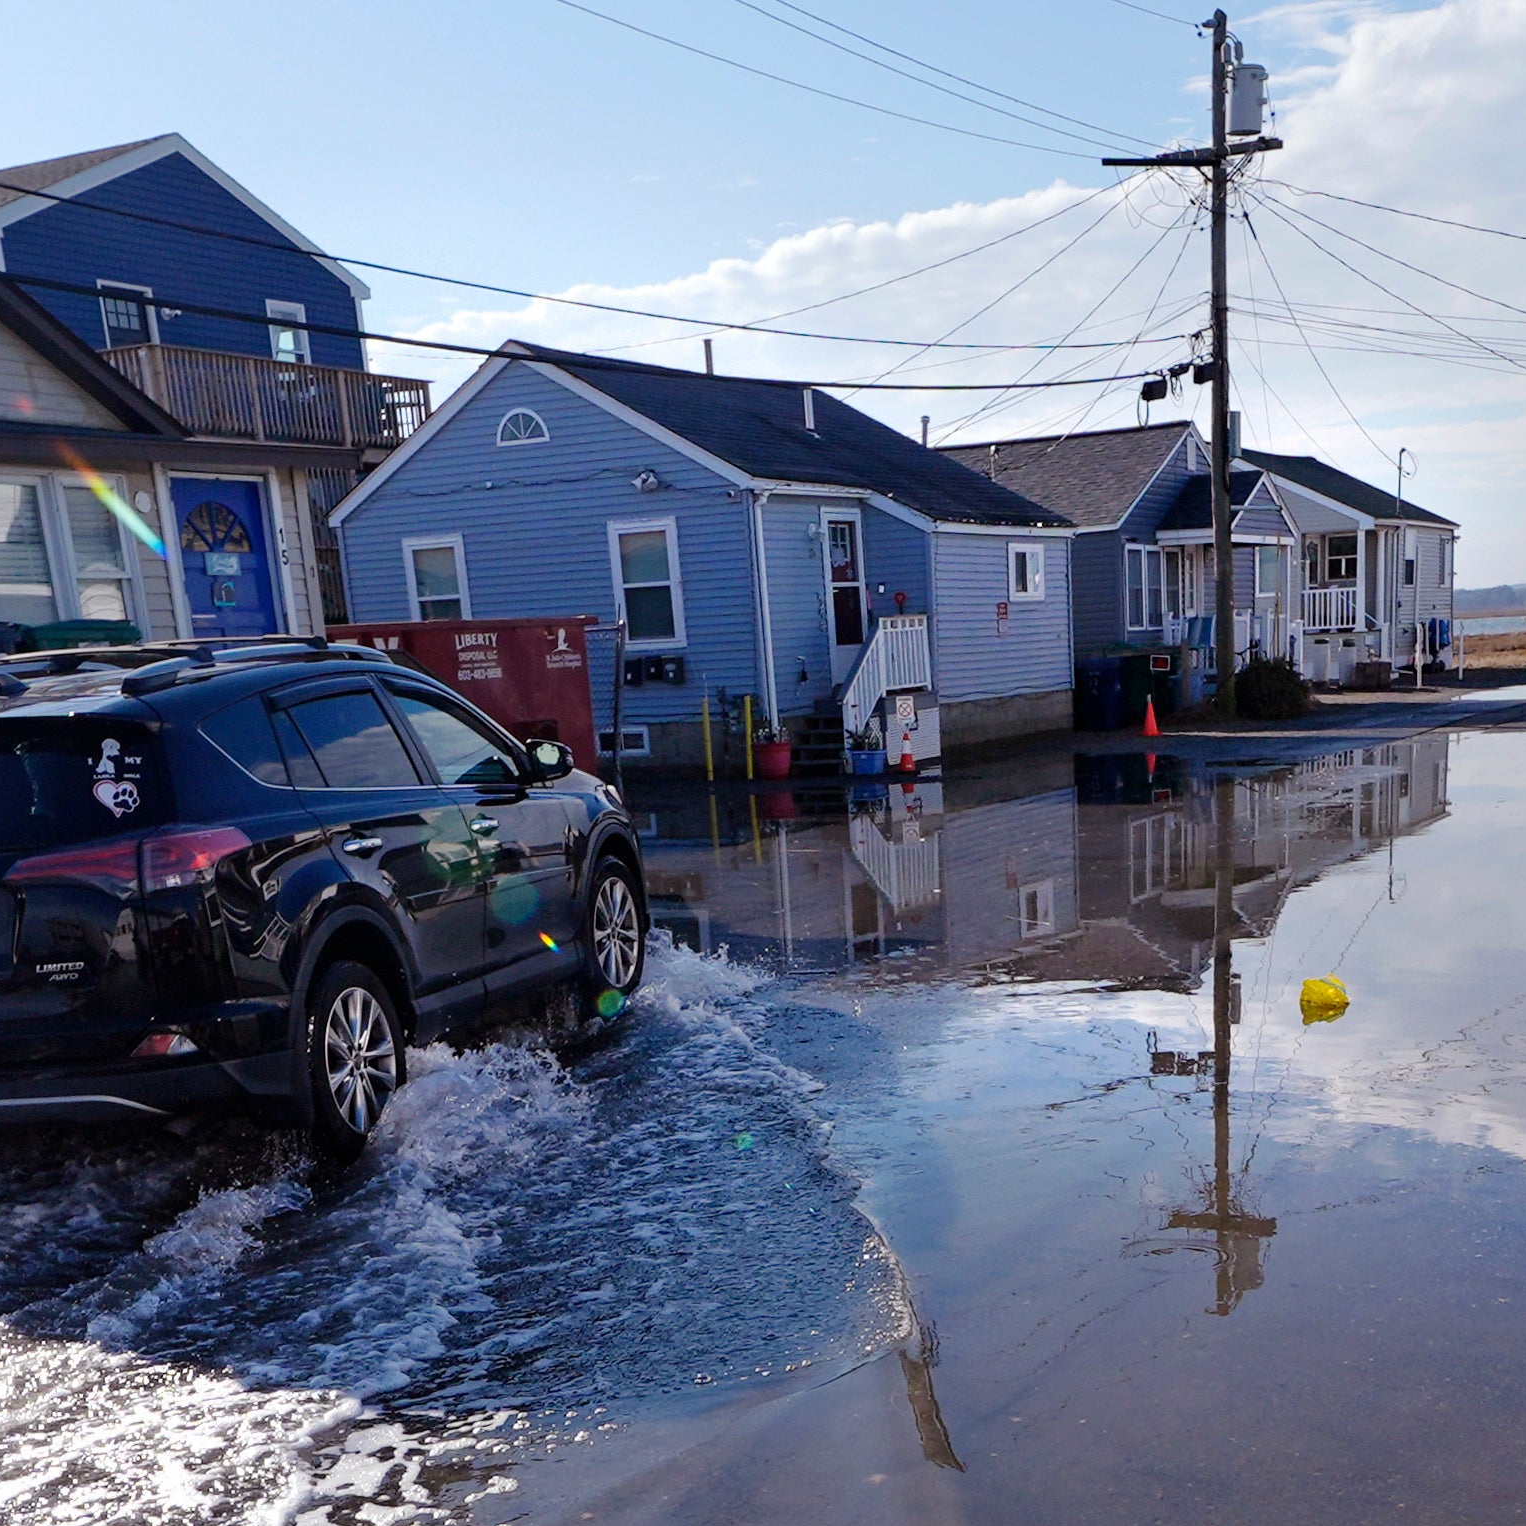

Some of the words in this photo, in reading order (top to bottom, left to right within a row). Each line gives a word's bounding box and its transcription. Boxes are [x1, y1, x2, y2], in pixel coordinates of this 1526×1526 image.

[455, 632, 498, 650] LIBERTY
[458, 651, 486, 661] DISPOSAL
[124, 756, 142, 764] MY
[36, 962, 84, 973] LIMITED
[49, 972, 79, 981] AWD
